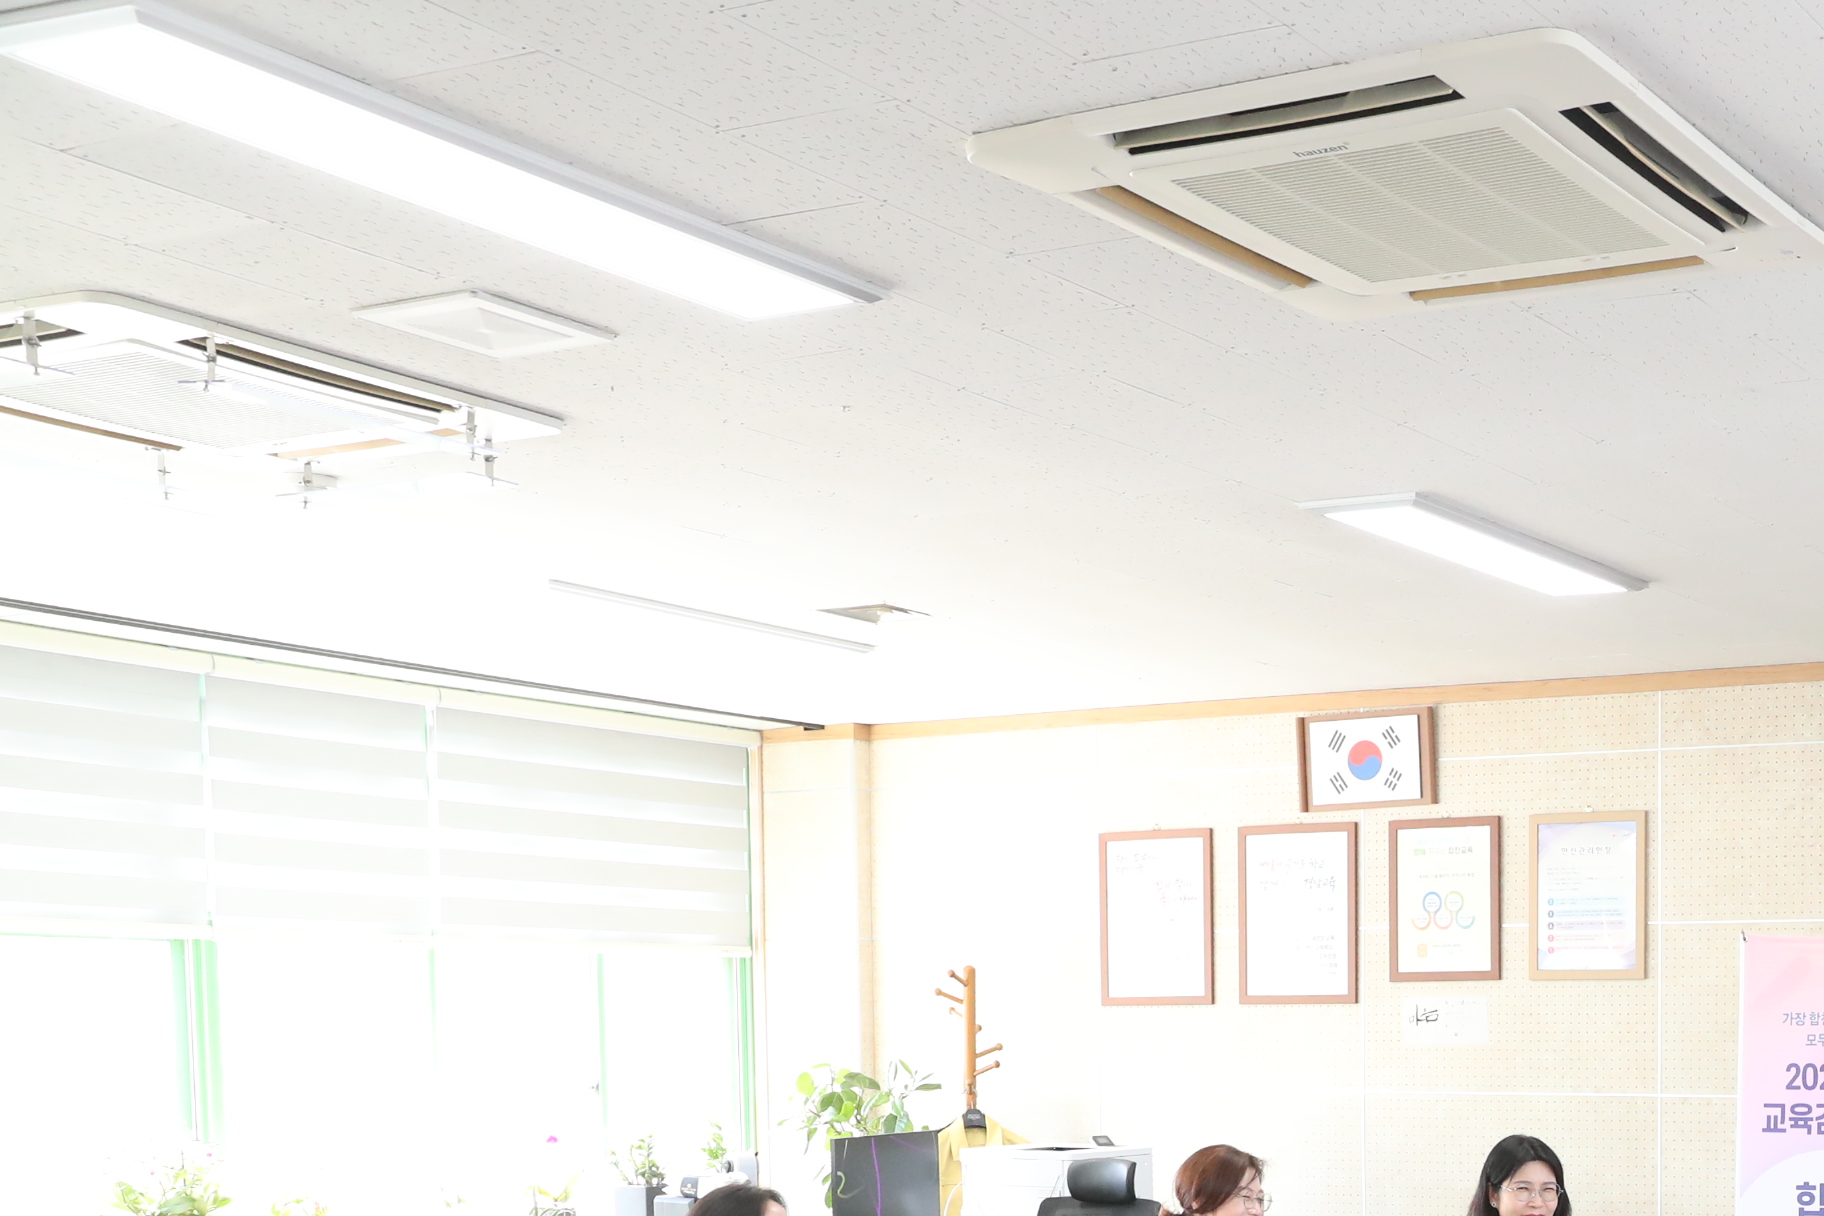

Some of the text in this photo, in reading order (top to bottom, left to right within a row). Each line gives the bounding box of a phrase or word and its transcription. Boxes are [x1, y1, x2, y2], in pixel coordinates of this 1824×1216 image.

[1293, 144, 1349, 157] hauzen
[1303, 876, 1337, 893] 경남교육
[1782, 1011, 1807, 1027] 가장
